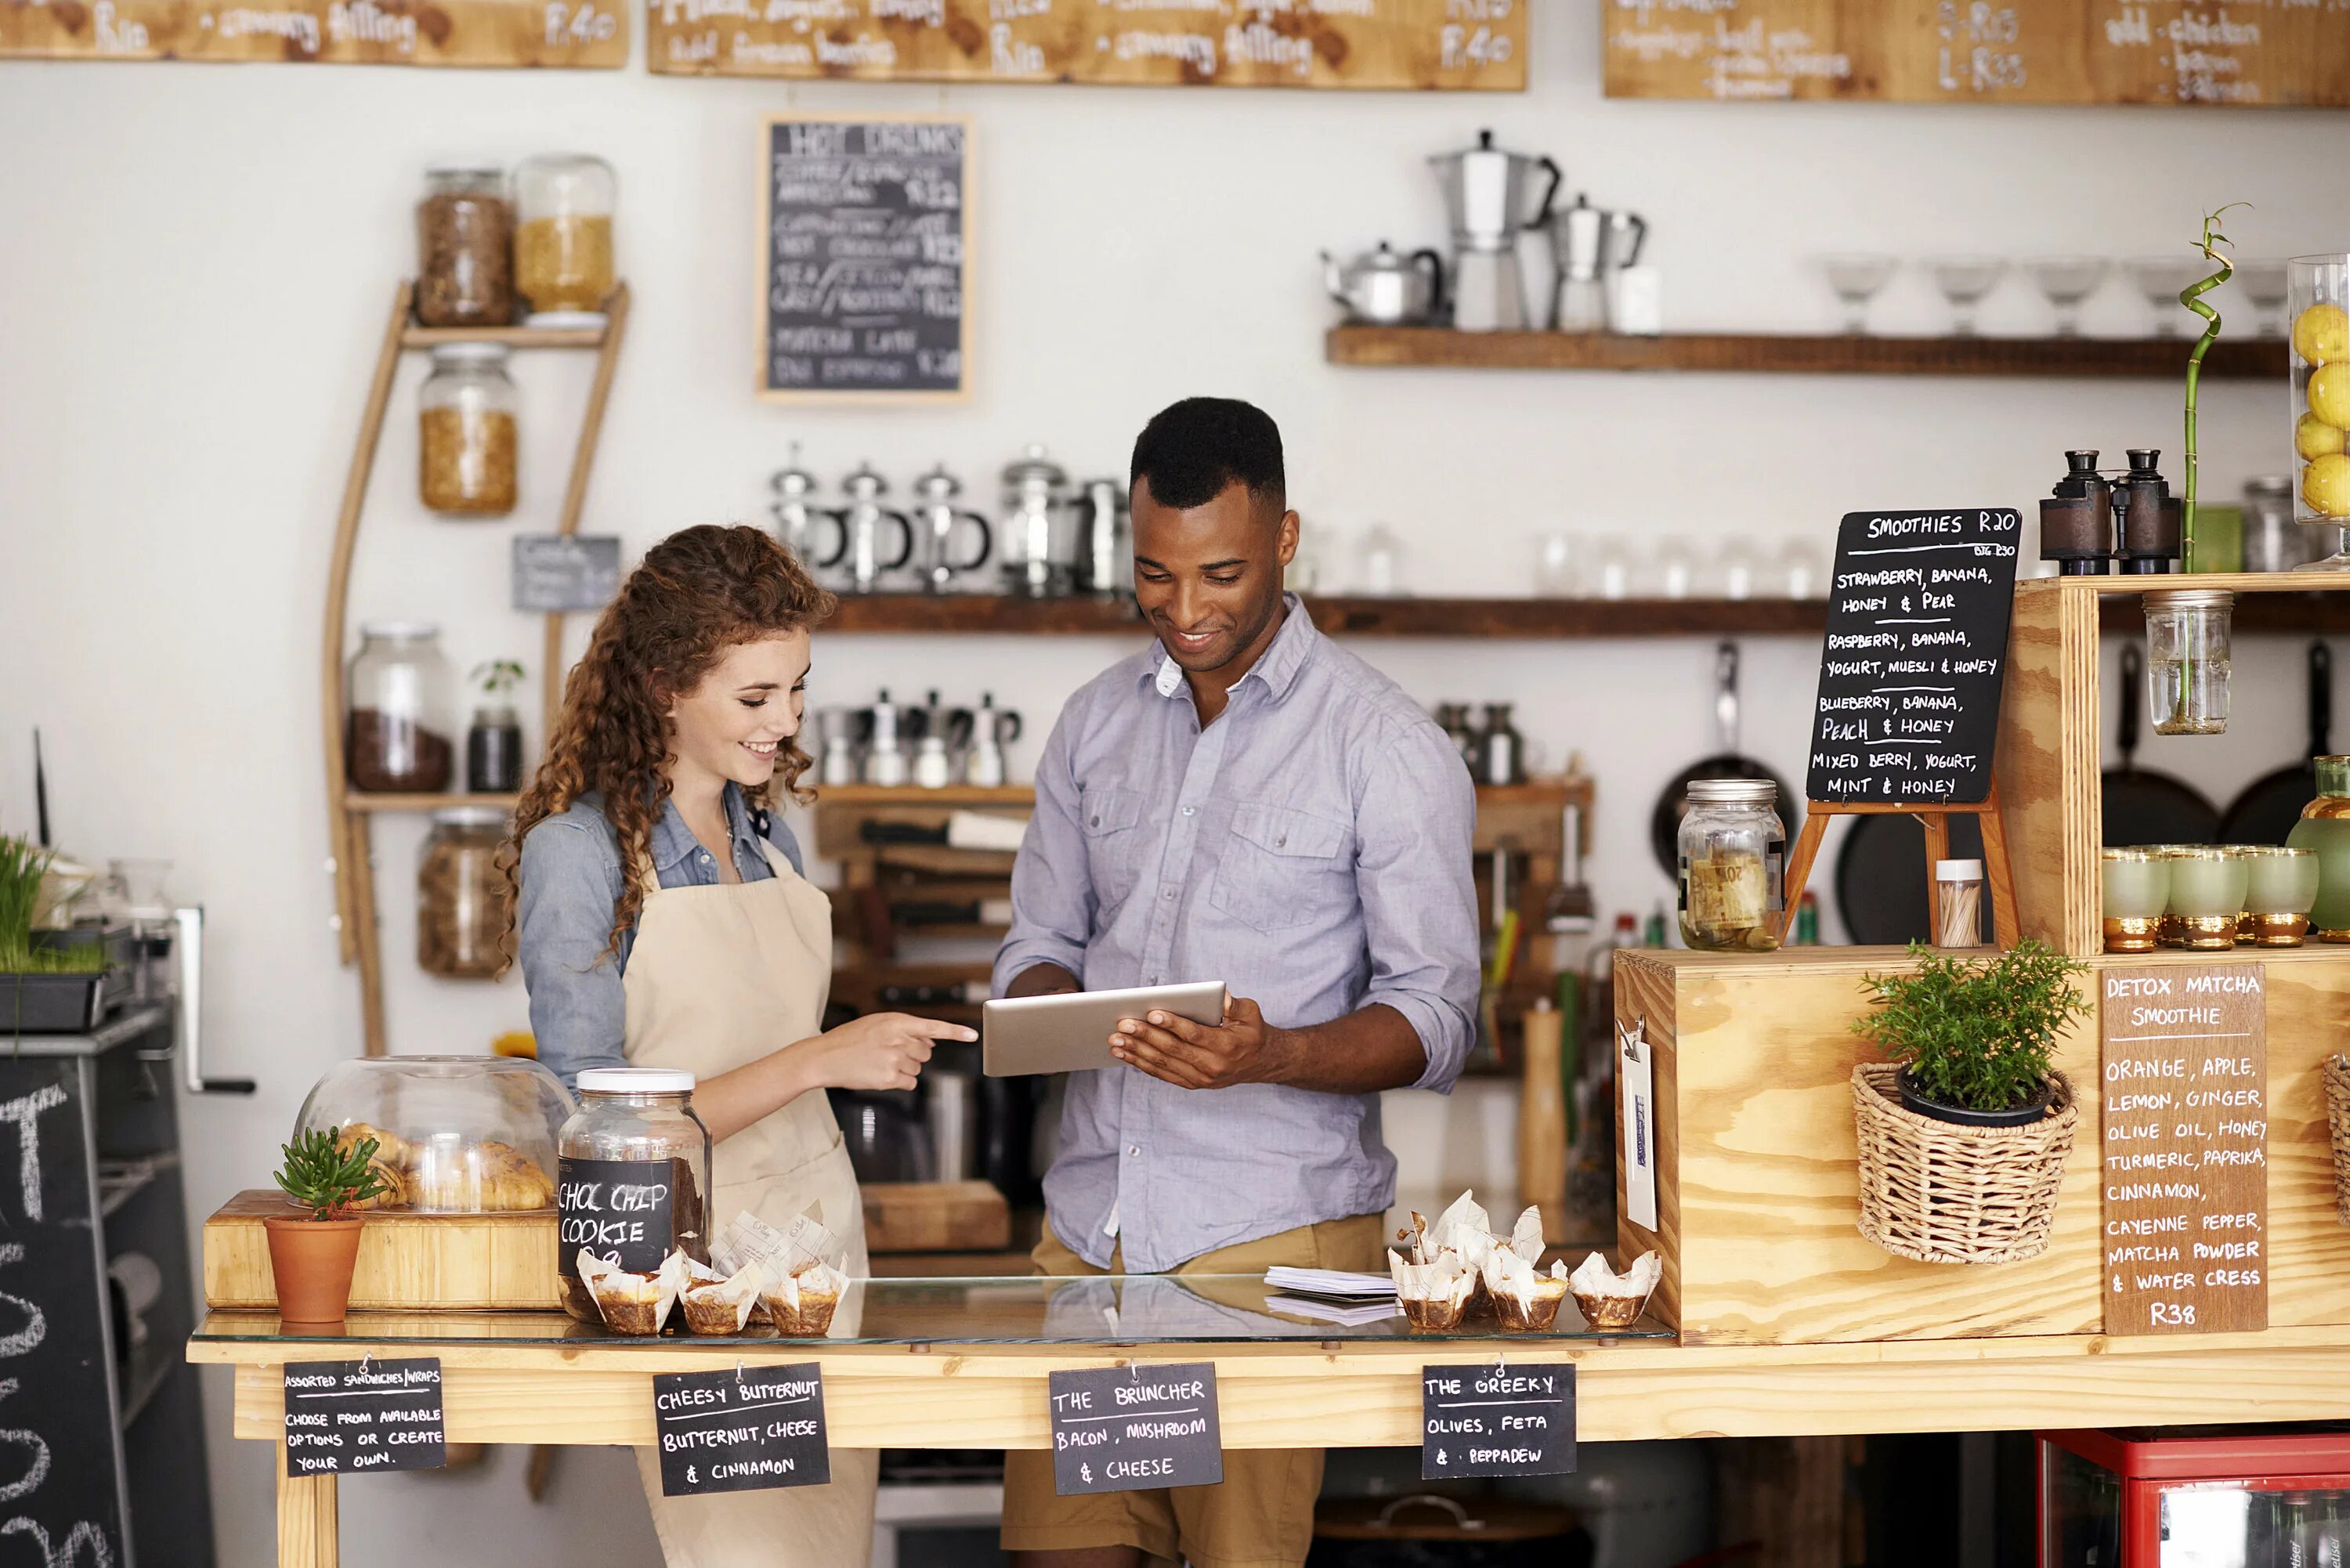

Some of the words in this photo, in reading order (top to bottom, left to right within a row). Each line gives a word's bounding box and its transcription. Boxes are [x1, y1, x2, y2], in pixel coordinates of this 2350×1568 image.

[1867, 516, 1962, 538] SMOOTHIES
[1979, 511, 2016, 533] R20
[1837, 569, 1927, 591] STRAWBERRY,
[1931, 567, 1992, 584] BANANA,
[1842, 597, 1886, 612] HONEY
[1901, 596, 1911, 613] &
[1922, 592, 1956, 609] PEAR
[1828, 633, 1905, 652] RASPBERRY,
[1911, 630, 1972, 648] BANANA,
[1827, 661, 1885, 679] YOGURT,
[1889, 659, 1934, 673] MUESLI
[1941, 659, 1950, 674] &
[1954, 659, 1998, 675] HONEY
[1820, 697, 1898, 715] BLUEBERRY,
[1903, 695, 1964, 712] BANANA,
[1821, 717, 1868, 741] PEACH
[1883, 718, 1892, 735] &
[1901, 719, 1954, 734] HONEY
[1812, 753, 1859, 768] MIXED
[1869, 752, 1918, 771] BERRY,
[1925, 754, 1976, 772] YOGURT,
[1828, 777, 1872, 793] MINT
[1882, 777, 1892, 794] &
[1901, 778, 1955, 793] HONEY
[2107, 978, 2171, 998] DETOX
[2186, 975, 2260, 994] MATCHA
[2131, 1006, 2221, 1026] SMOOTHIE
[2106, 1059, 2196, 1082] ORANGE,
[2203, 1057, 2256, 1076] APPLE,
[2109, 1092, 2180, 1111] LEMON,
[2186, 1089, 2262, 1108] GINGER,
[2108, 1123, 2160, 1140] OLIVE
[2175, 1123, 2212, 1140] OIL,
[2218, 1119, 2266, 1140] HONEY
[2107, 1152, 2200, 1171] TURMERIC,
[2204, 1147, 2265, 1167] PAPRIKA,
[559, 1183, 602, 1212] CHOC
[611, 1183, 667, 1211] CHIP
[2107, 1183, 2207, 1201] CINNAMON,
[562, 1218, 644, 1245] COOKIE
[2107, 1215, 2188, 1235] CAYENNE
[2203, 1212, 2261, 1232] PEPPER,
[2109, 1247, 2179, 1266] MATCHA
[2193, 1241, 2259, 1259] POWDER
[2113, 1274, 2123, 1292] &
[2136, 1273, 2195, 1290] WATER
[2205, 1269, 2261, 1286] CRESS
[2150, 1302, 2196, 1325] R38
[285, 1376, 336, 1387] ASSORTED
[1426, 1379, 1461, 1395] THE
[1475, 1376, 1553, 1393] GREEKY
[657, 1389, 726, 1410] CHEESY
[739, 1381, 819, 1401] BUTTERNUT
[1053, 1392, 1092, 1412] THE
[1115, 1381, 1205, 1405] BRUNCHER
[285, 1414, 328, 1426] CHOOSE
[338, 1413, 371, 1425] FROM
[380, 1409, 441, 1423] AVAILABLE
[1427, 1419, 1492, 1436] OLIVES,
[1502, 1416, 1547, 1431] FETA
[287, 1433, 343, 1447] OPTIONS
[358, 1434, 378, 1446] OR
[389, 1431, 443, 1444] CREATE
[663, 1426, 765, 1452] BUTTERNUT,
[767, 1420, 817, 1438] CHEESE
[1056, 1429, 1119, 1451] BACON,
[1126, 1418, 1206, 1440] MUSHROOM
[296, 1457, 338, 1471] YOUR
[353, 1451, 396, 1467] OWN.
[1437, 1448, 1448, 1465] &
[1470, 1448, 1542, 1464] PEPPADEW
[687, 1465, 699, 1483] &
[712, 1458, 794, 1479] CINNAMON
[1080, 1462, 1093, 1483] &
[1106, 1458, 1174, 1479] CHEESE
